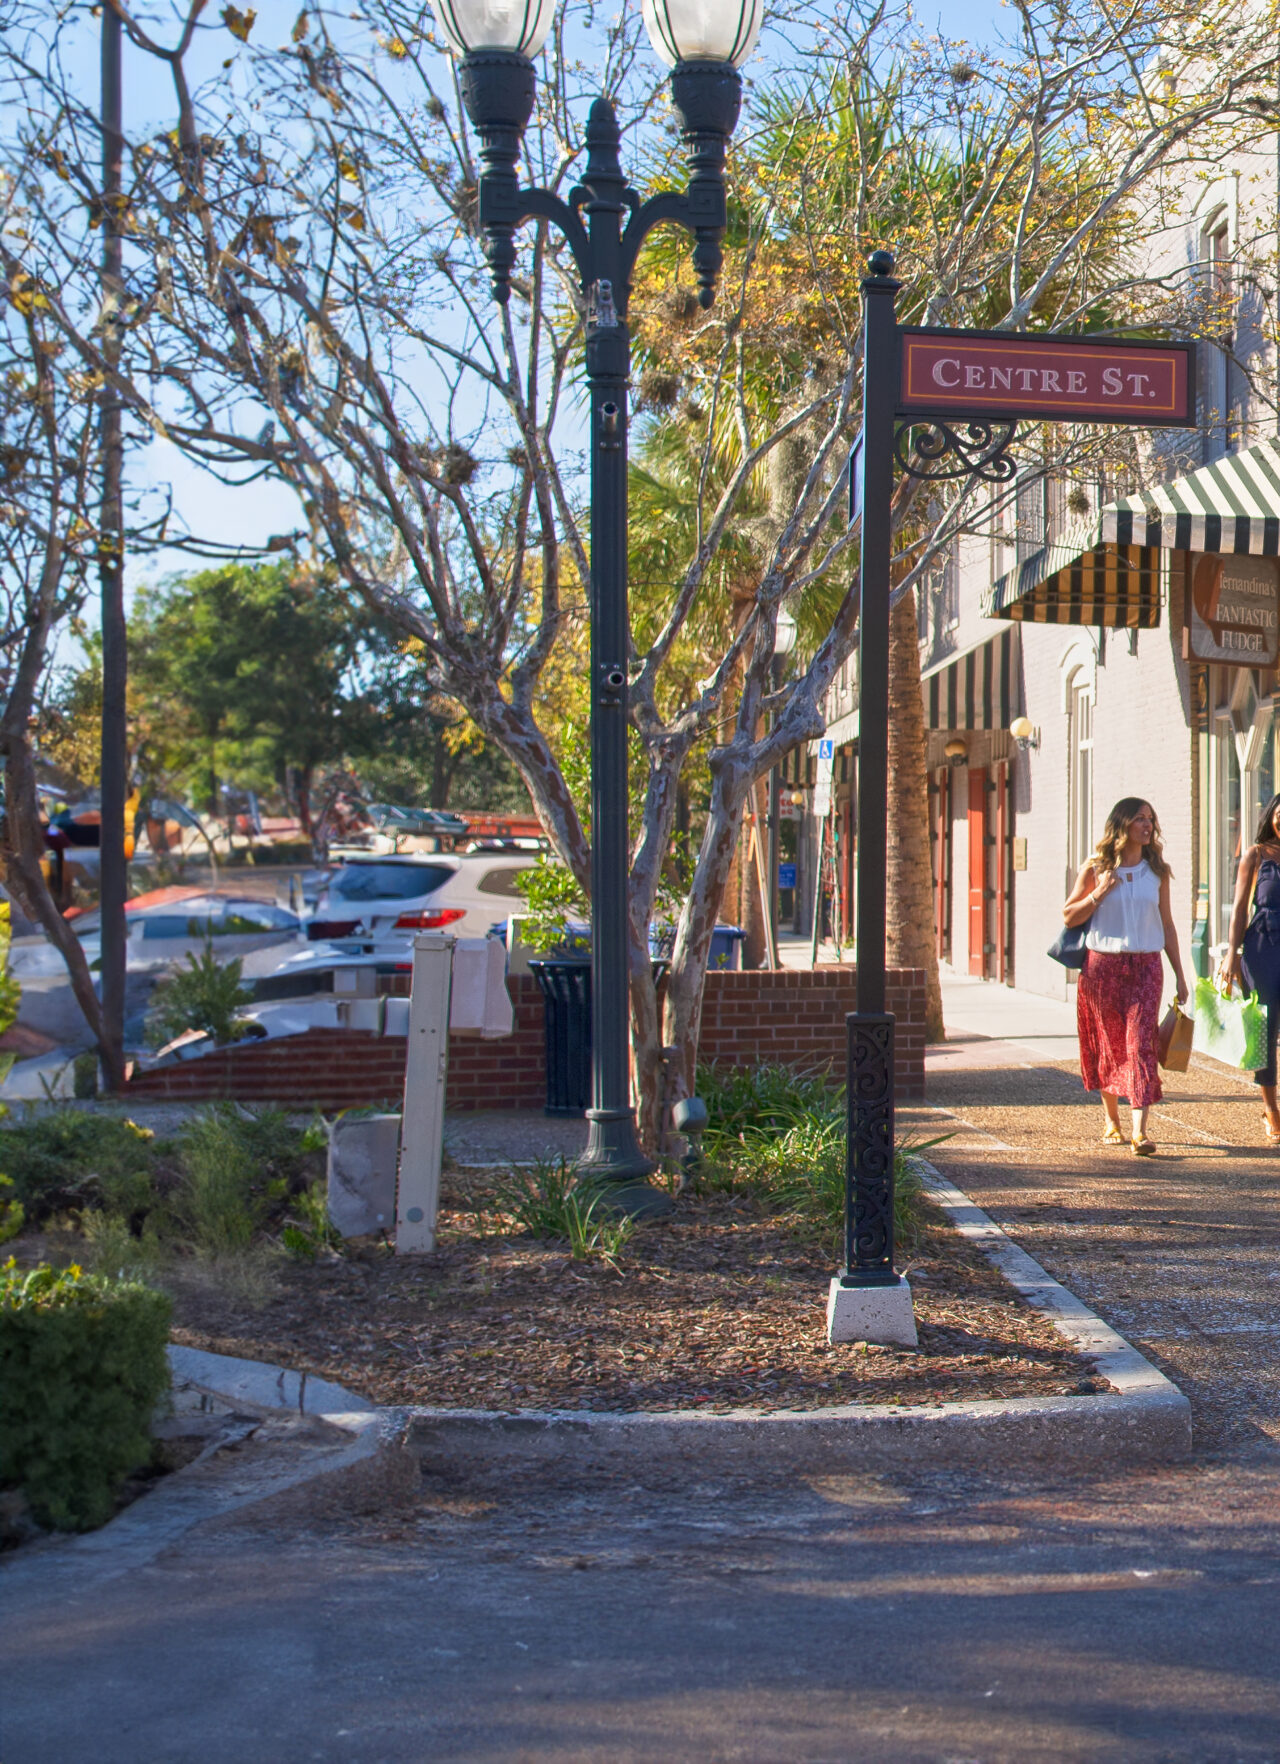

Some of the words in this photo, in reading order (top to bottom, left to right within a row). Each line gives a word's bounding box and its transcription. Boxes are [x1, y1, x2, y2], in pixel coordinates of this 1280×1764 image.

[931, 358, 1088, 394] CENTRE
[1101, 366, 1157, 398] ST.
[1216, 604, 1278, 628] FANTASTIC
[1221, 630, 1264, 652] FUDGE
